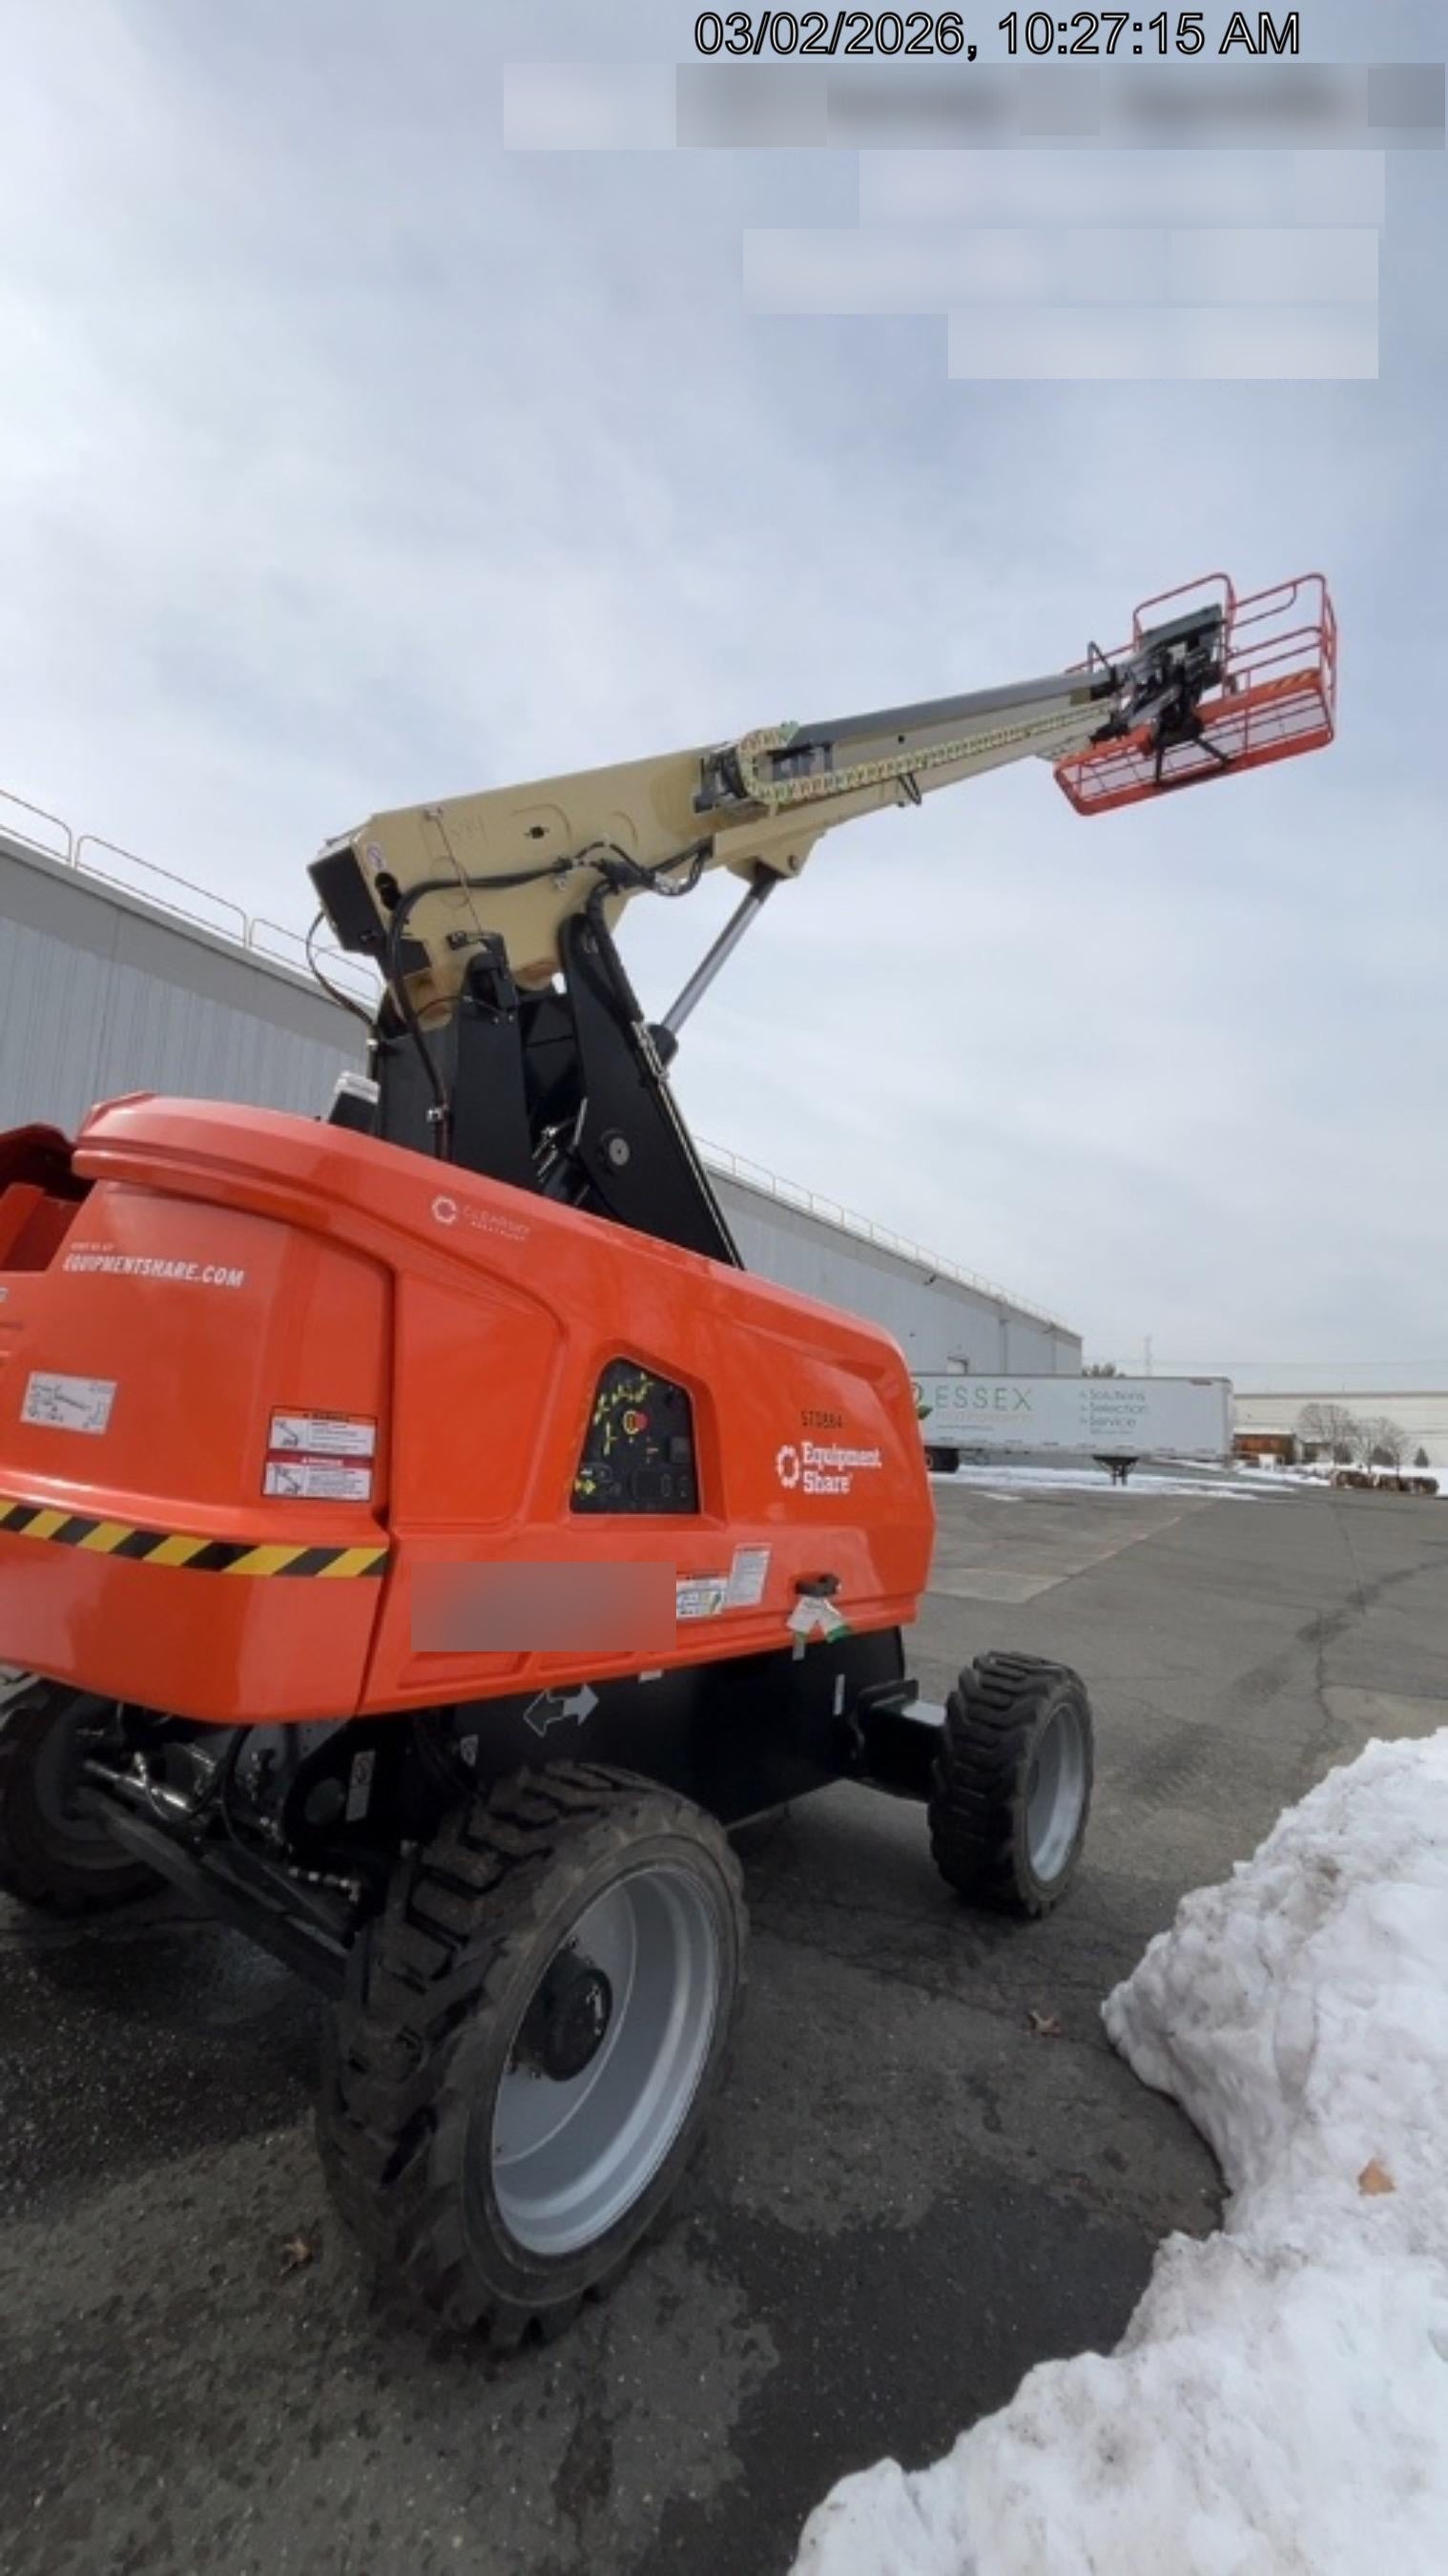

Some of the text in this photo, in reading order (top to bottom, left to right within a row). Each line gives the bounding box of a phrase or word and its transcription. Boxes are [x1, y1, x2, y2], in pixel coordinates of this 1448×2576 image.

[62, 1253, 244, 1287] EQUIPMENTSHARE.COM
[934, 1384, 1033, 1412] ESSEX
[800, 1441, 882, 1471] Equipment
[803, 1470, 851, 1495] Share
